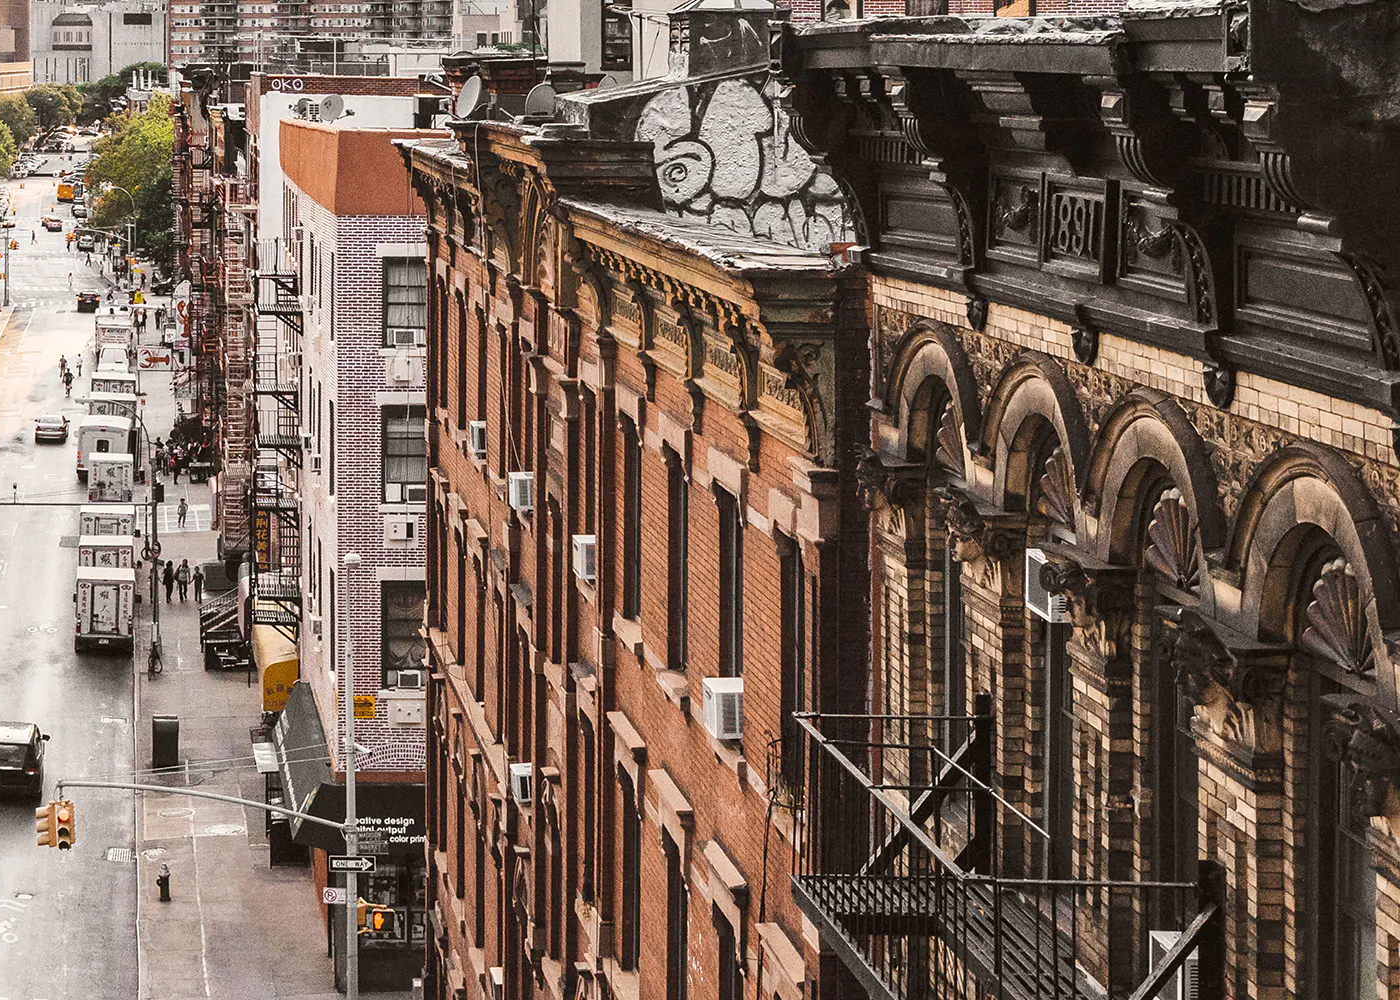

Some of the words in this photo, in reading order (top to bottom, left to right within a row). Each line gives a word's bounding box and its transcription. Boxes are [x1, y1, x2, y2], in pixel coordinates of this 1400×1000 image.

[271, 78, 304, 91] OKO
[384, 817, 415, 826] design
[389, 835, 408, 843] color
